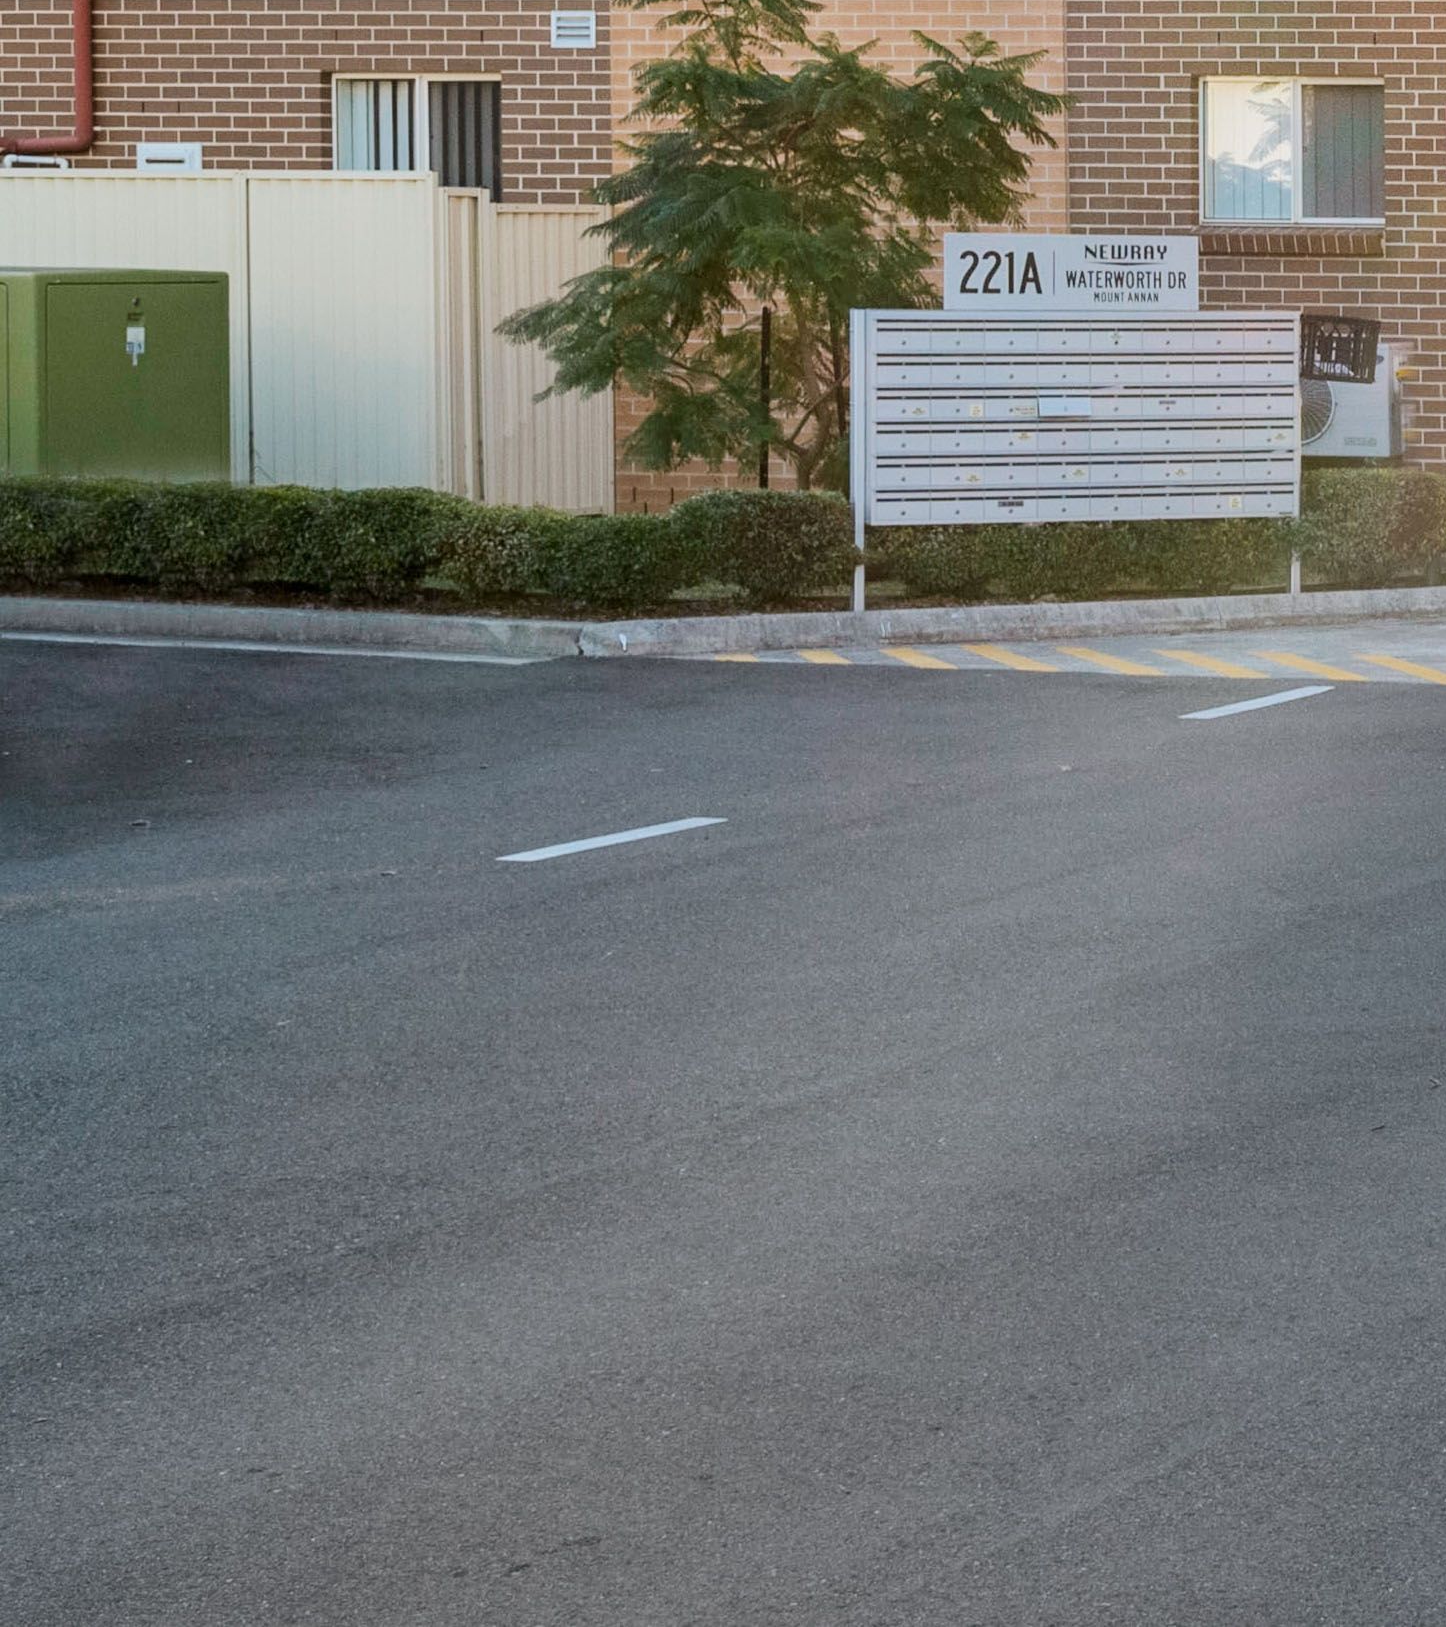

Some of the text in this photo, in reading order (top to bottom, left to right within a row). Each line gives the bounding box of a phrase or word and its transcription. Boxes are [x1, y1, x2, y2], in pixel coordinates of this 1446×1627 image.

[1084, 244, 1168, 260] NEWRAY
[959, 250, 1043, 295] 221A
[1065, 270, 1187, 290] WATERWORTH DR
[1093, 292, 1160, 303] MOUNT ANNAN
